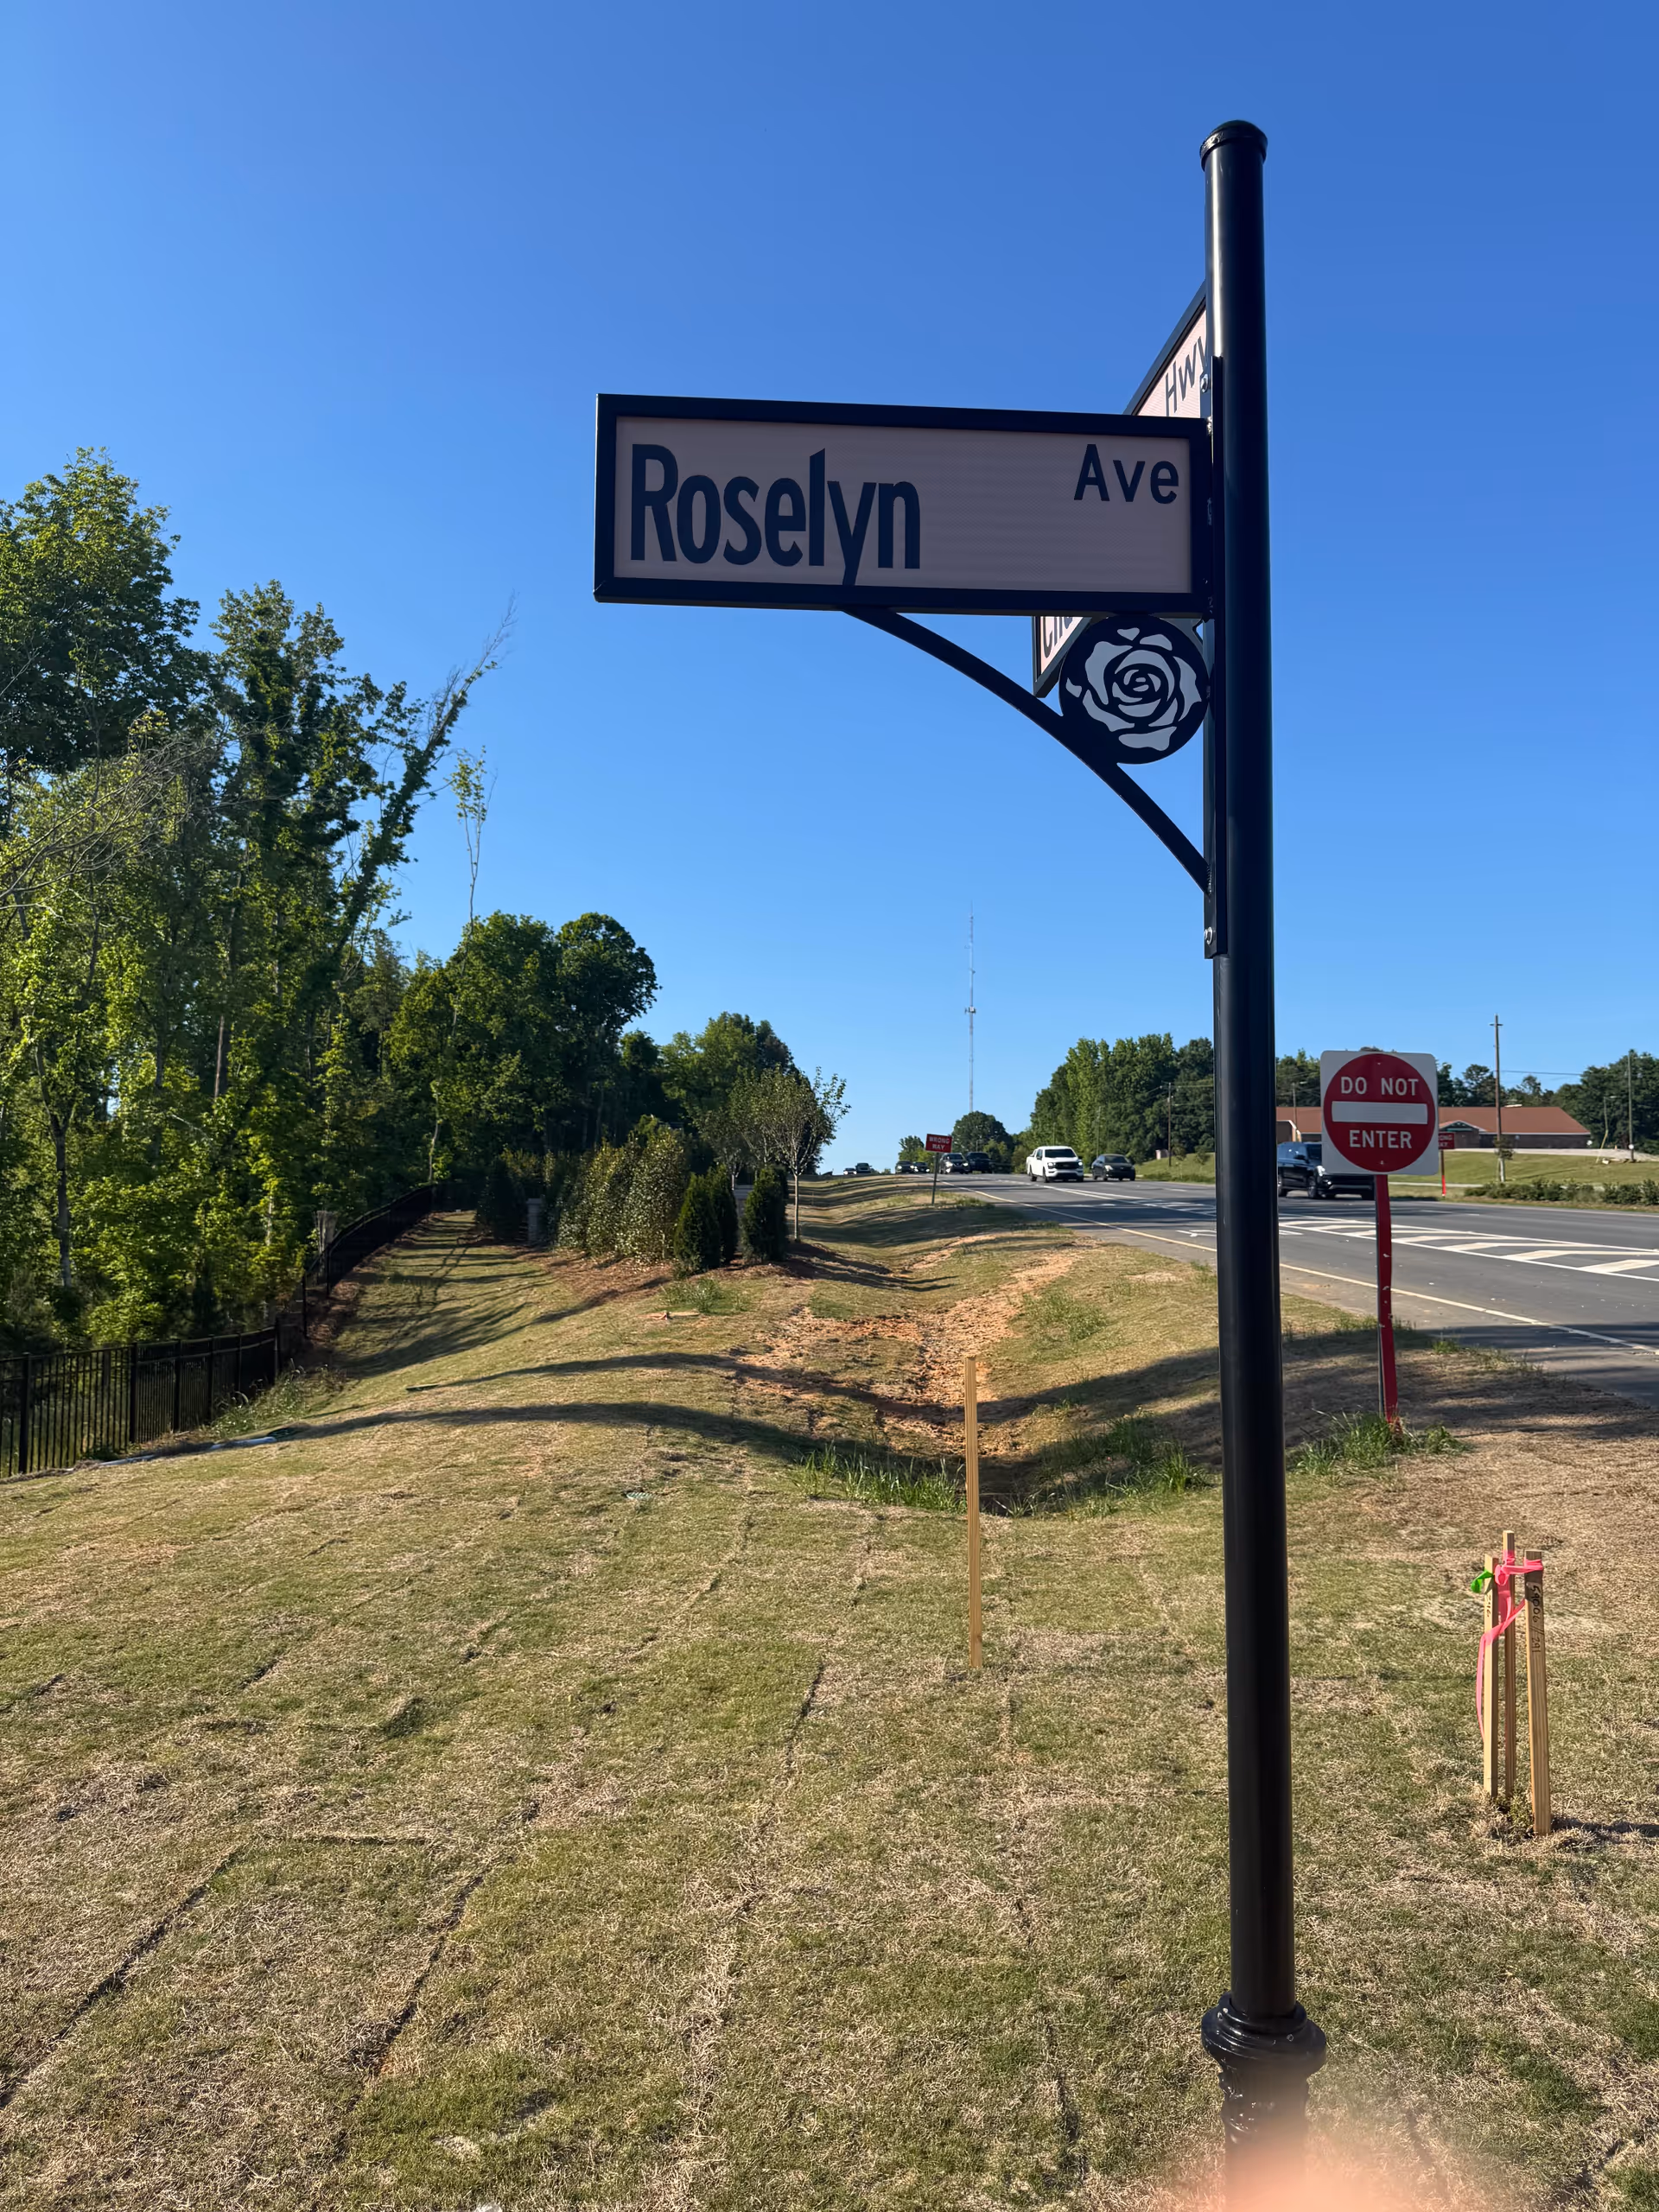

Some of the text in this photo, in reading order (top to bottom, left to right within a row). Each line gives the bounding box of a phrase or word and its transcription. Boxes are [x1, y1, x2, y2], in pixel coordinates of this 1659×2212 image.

[630, 443, 1179, 586] Roselyn Ave
[1340, 1077, 1419, 1096] DO NOT
[1349, 1129, 1412, 1149] ENTER
